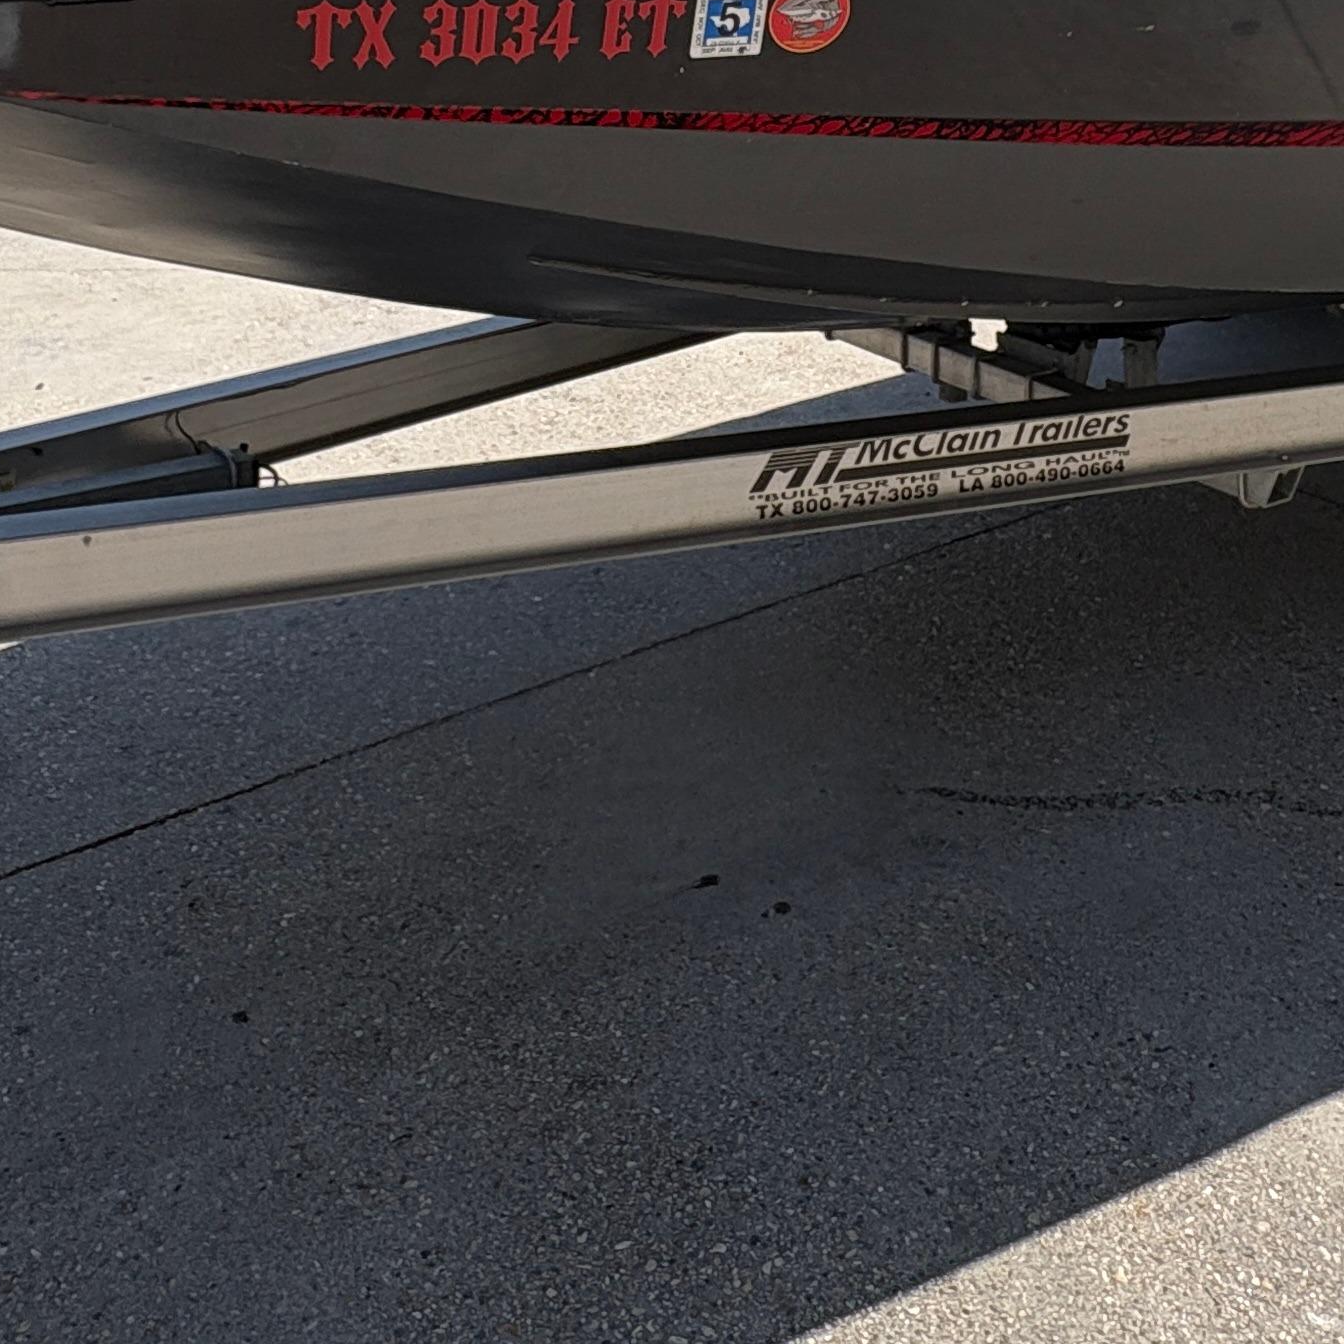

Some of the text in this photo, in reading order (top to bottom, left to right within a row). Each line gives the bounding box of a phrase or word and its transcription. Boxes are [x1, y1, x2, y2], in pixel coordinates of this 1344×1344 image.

[719, 1, 743, 37] 5
[855, 413, 1131, 465] McClain Trailers
[756, 459, 1126, 520] TX 800-747-3059 LA 800-490-0664
[839, 479, 890, 493] FOR
[896, 471, 942, 485] THE
[951, 461, 1036, 479] LONG
